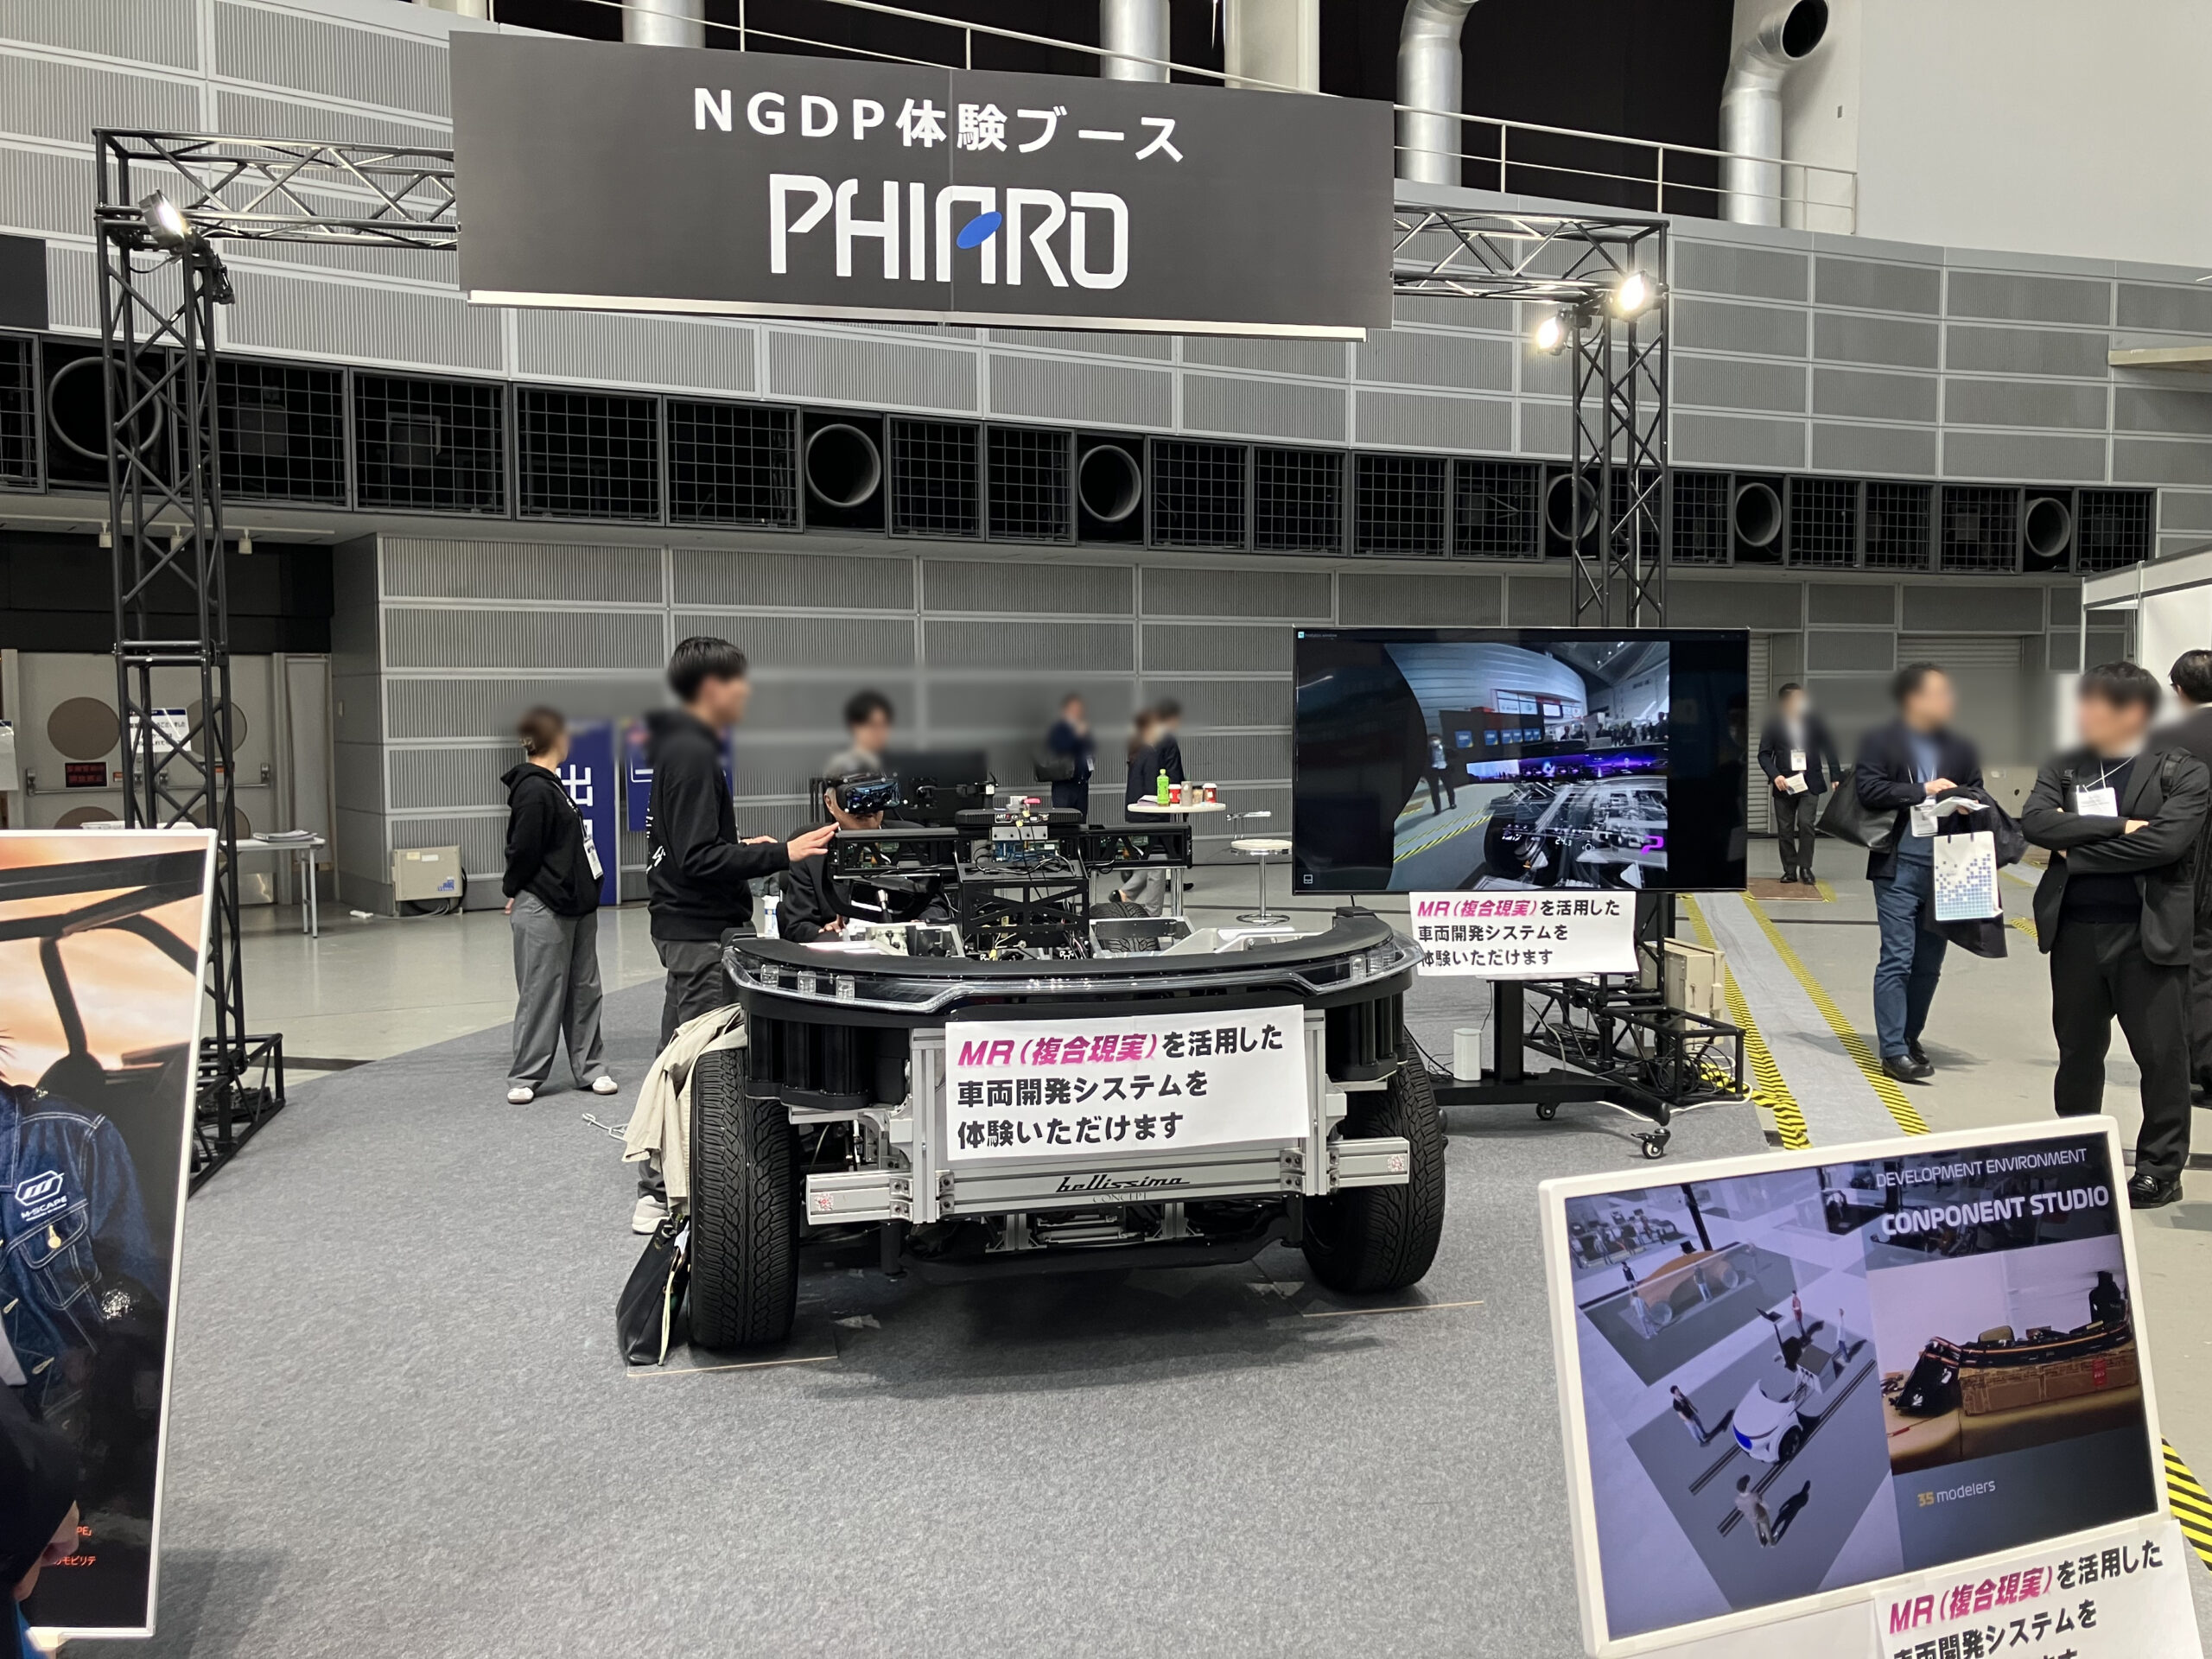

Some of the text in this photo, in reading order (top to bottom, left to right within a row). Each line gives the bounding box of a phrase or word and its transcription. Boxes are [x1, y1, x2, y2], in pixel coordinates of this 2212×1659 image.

[694, 87, 1183, 162] NGDP体験ブース
[1418, 924, 1568, 943] 車両開発システムを
[1421, 948, 1553, 968] 体験いただけます
[957, 1024, 1283, 1066] MR（複合現実）を活用した
[957, 1070, 1208, 1108] 車両開発システムを
[957, 1111, 1184, 1150] 体験いただけます
[1876, 1147, 2087, 1188] DEVELOPMENT ENVIRONMENT
[1092, 1192, 1147, 1204] CONCEPT
[1881, 1185, 2109, 1236] CONPONENT STUDIO
[1936, 1479, 1996, 1504] modelers
[1889, 1540, 2164, 1635] MR（複合現実）を活用した
